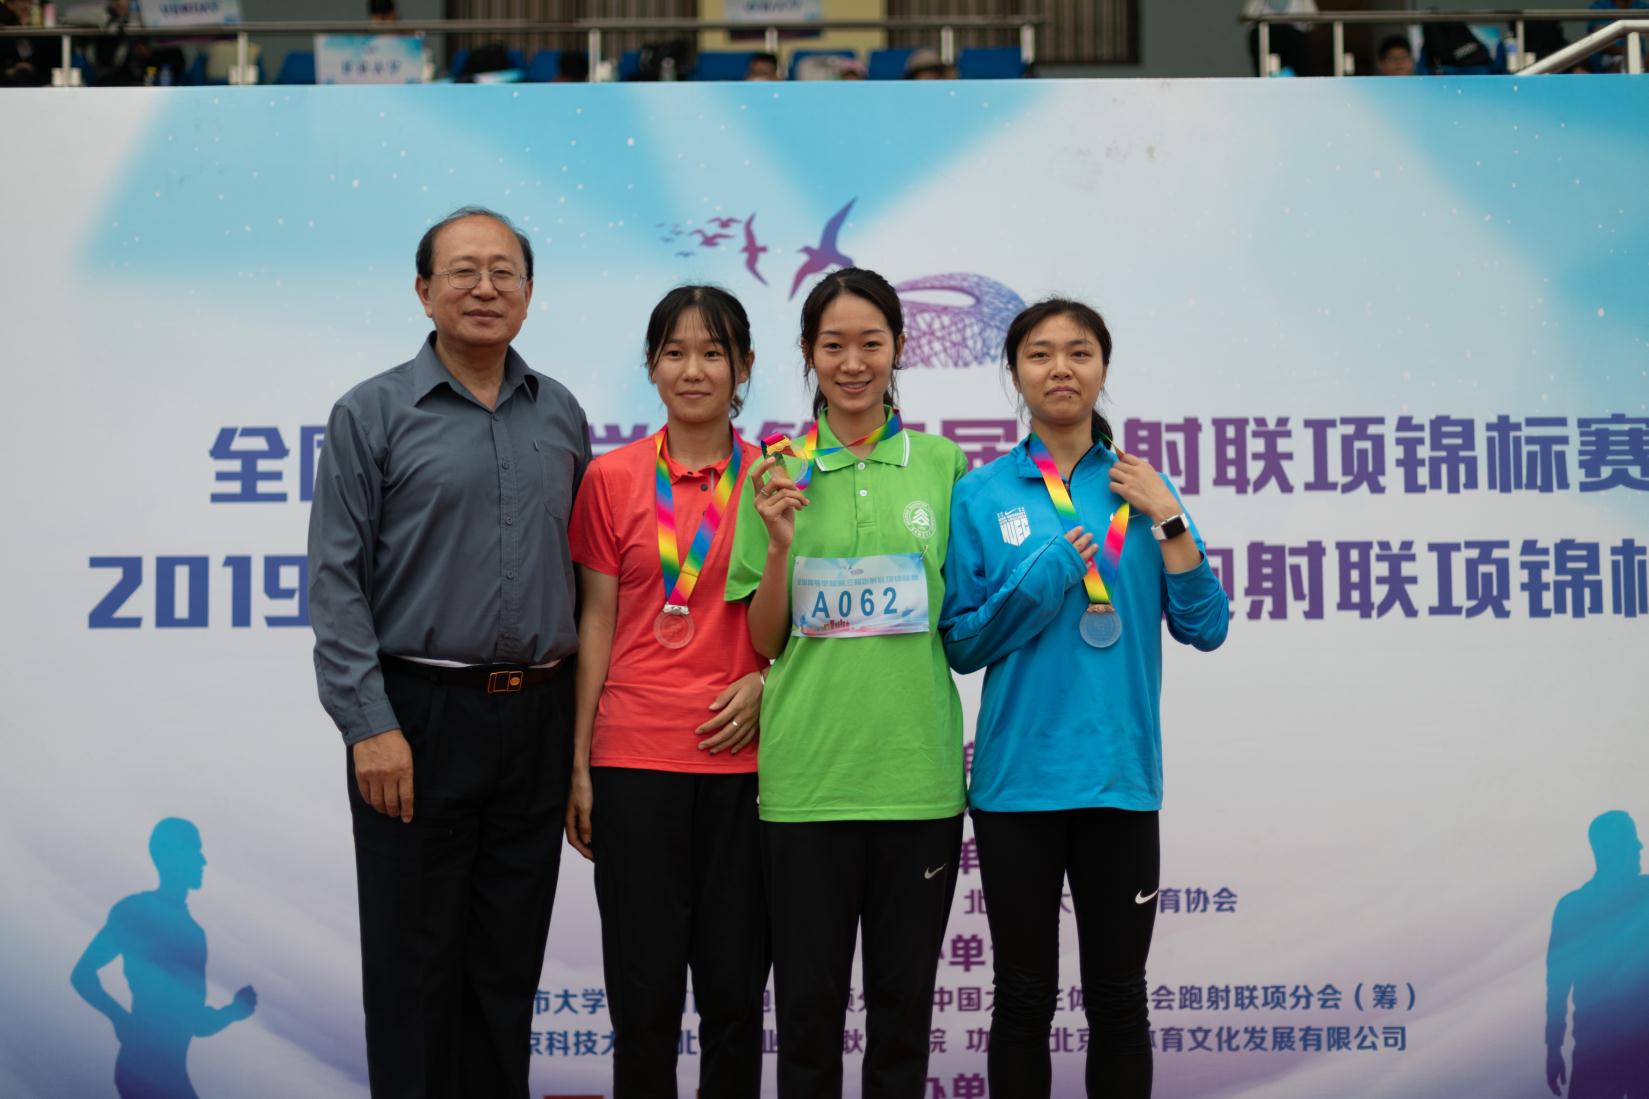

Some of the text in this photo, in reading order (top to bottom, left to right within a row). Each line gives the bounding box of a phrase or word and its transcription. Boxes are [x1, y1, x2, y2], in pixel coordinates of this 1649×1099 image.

[1124, 413, 1649, 495] 射联项锦标赛
[88, 555, 312, 628] 2019
[811, 587, 898, 618] A062
[1158, 887, 1238, 914] 育协会
